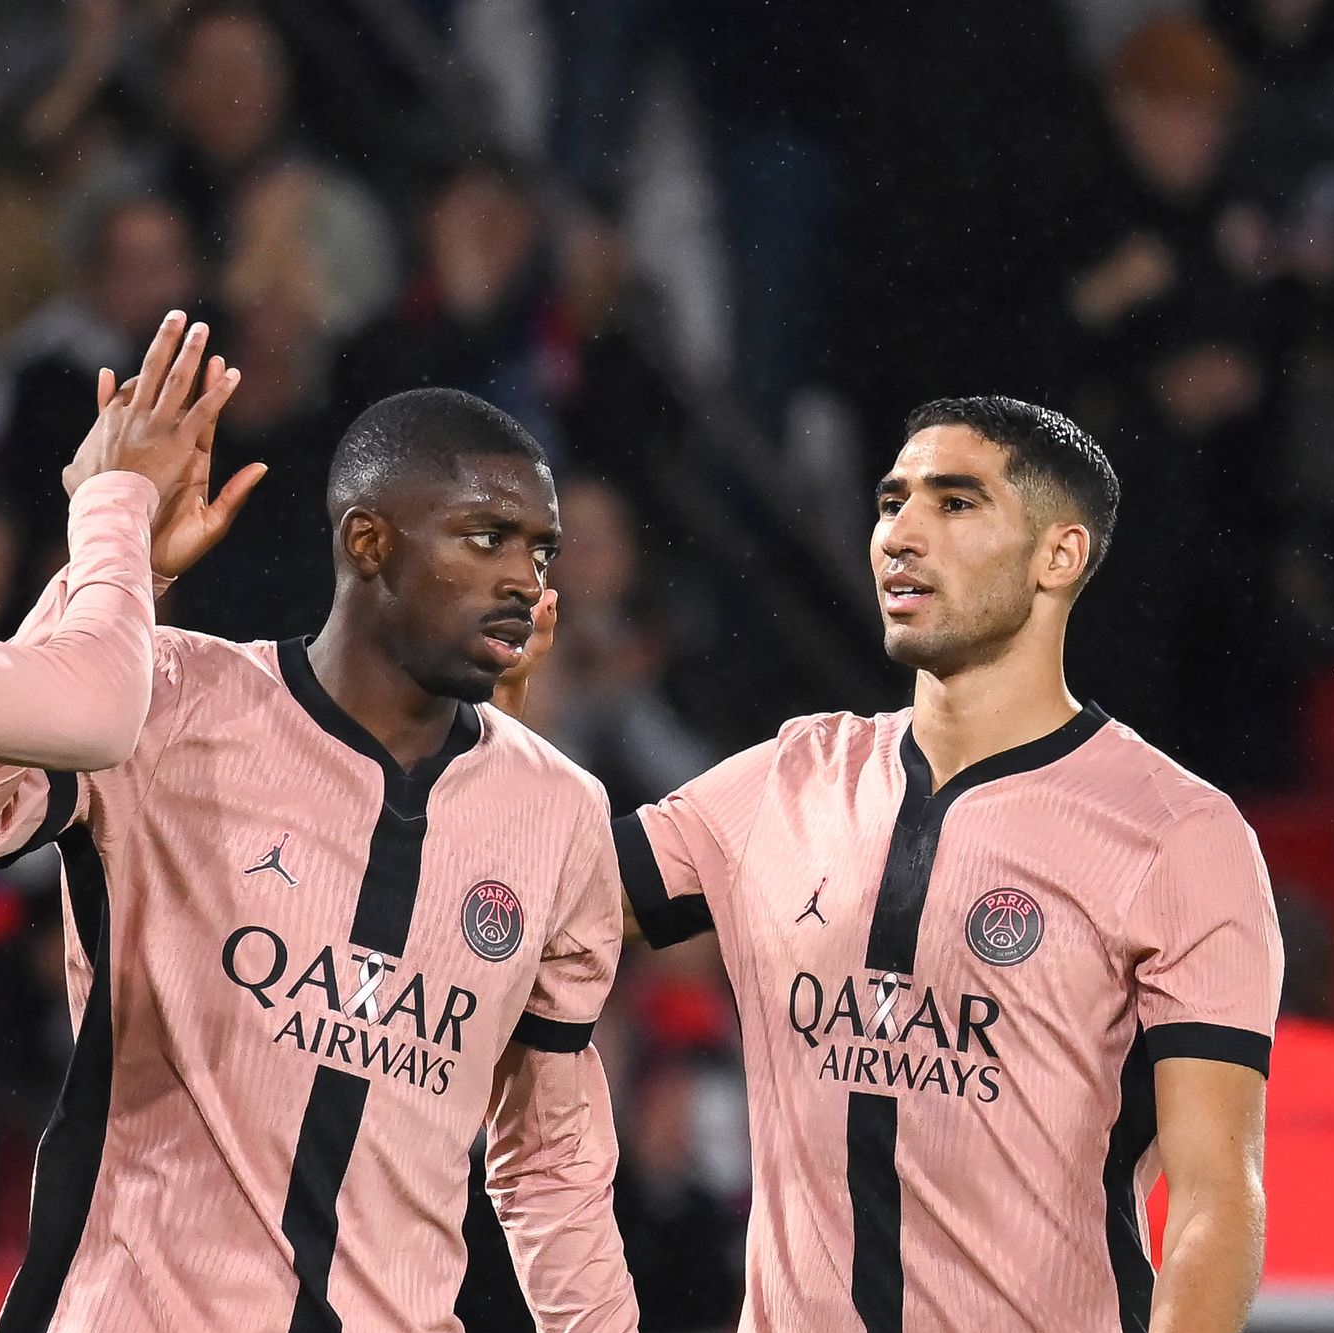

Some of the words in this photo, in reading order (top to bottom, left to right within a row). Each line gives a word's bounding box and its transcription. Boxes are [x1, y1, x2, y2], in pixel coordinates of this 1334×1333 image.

[477, 887, 516, 912] PARIS
[985, 894, 1033, 916] PARIS
[273, 1011, 455, 1096] AIRWAYS
[819, 1044, 1000, 1103] AIRWAYS
